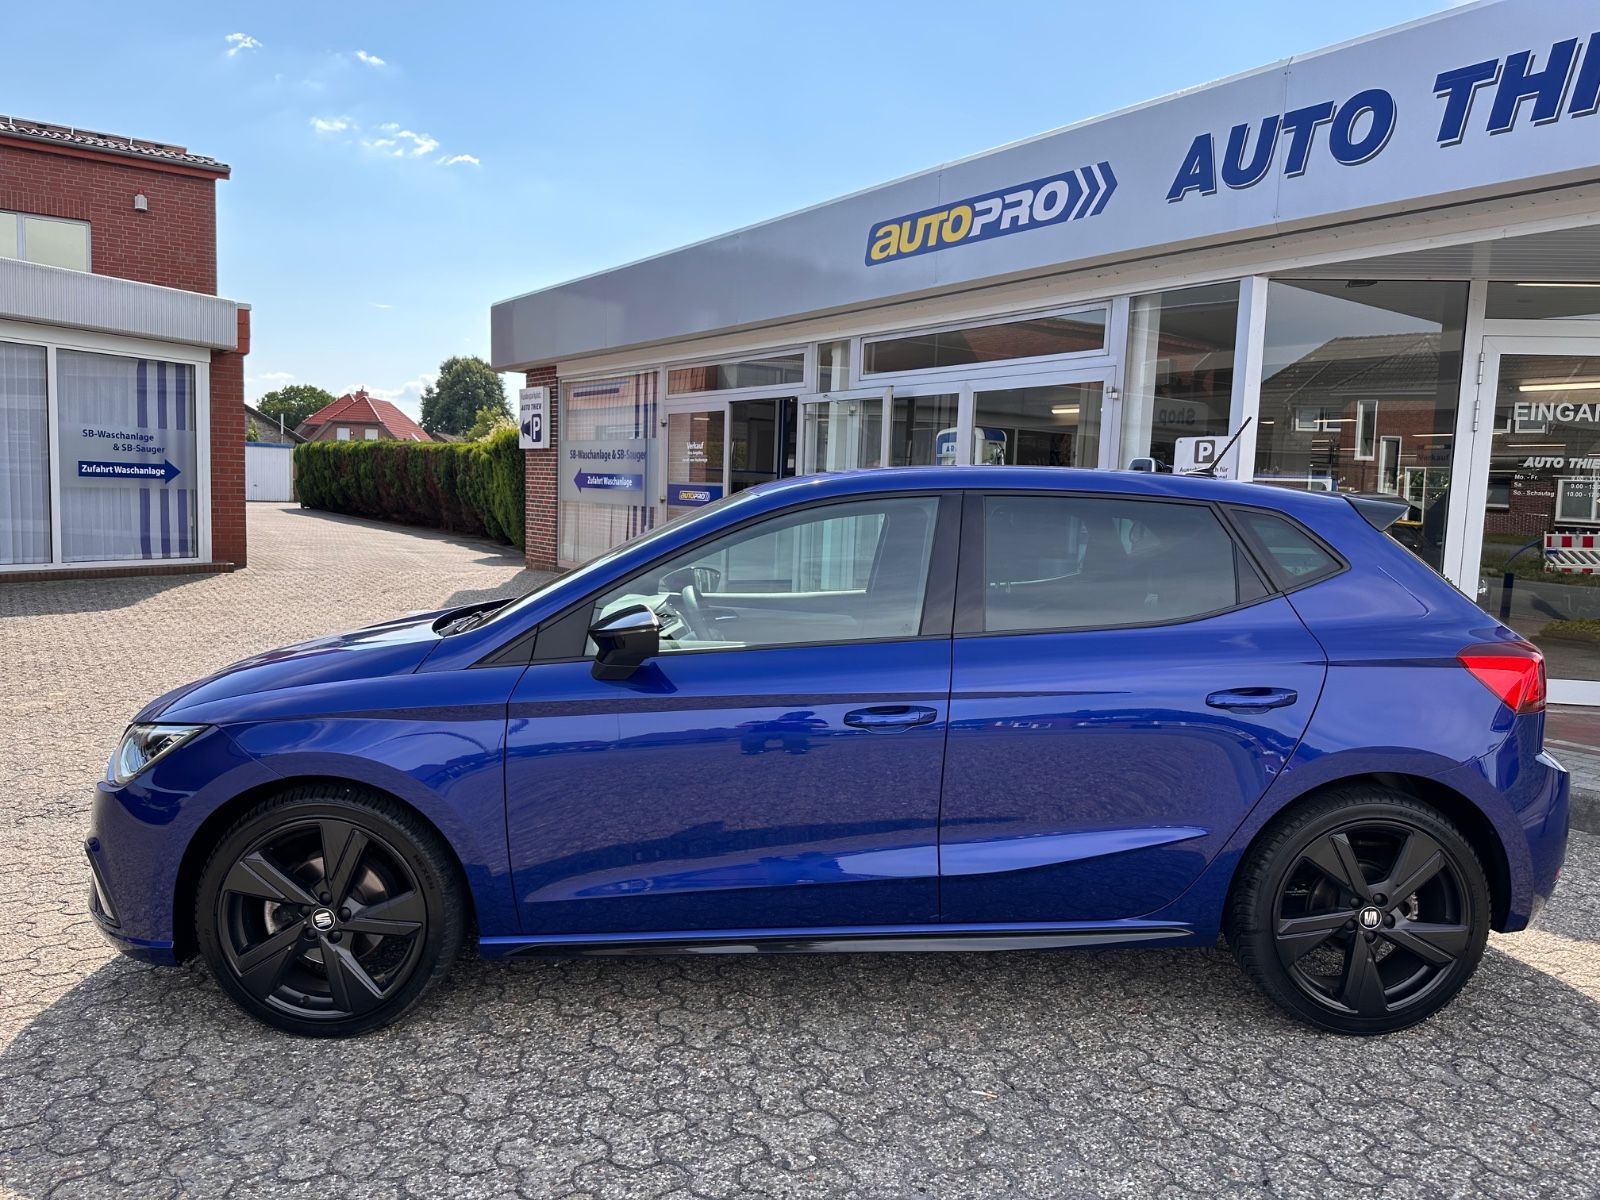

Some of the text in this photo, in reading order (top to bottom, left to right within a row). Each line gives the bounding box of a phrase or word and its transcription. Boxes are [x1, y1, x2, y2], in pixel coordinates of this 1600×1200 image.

[1165, 88, 1397, 204] AUTO
[533, 416, 541, 440] P
[82, 429, 154, 443] SB-Waschanlage
[113, 443, 166, 455] & SB-Sauger
[570, 449, 647, 462] SB-Waschanlage & SB-Sauger
[1198, 442, 1213, 462] P
[1523, 456, 1565, 468] AUTO
[81, 464, 166, 477] Zufahrt Waschanlage
[587, 476, 633, 488] Zufahrt Waschanlage
